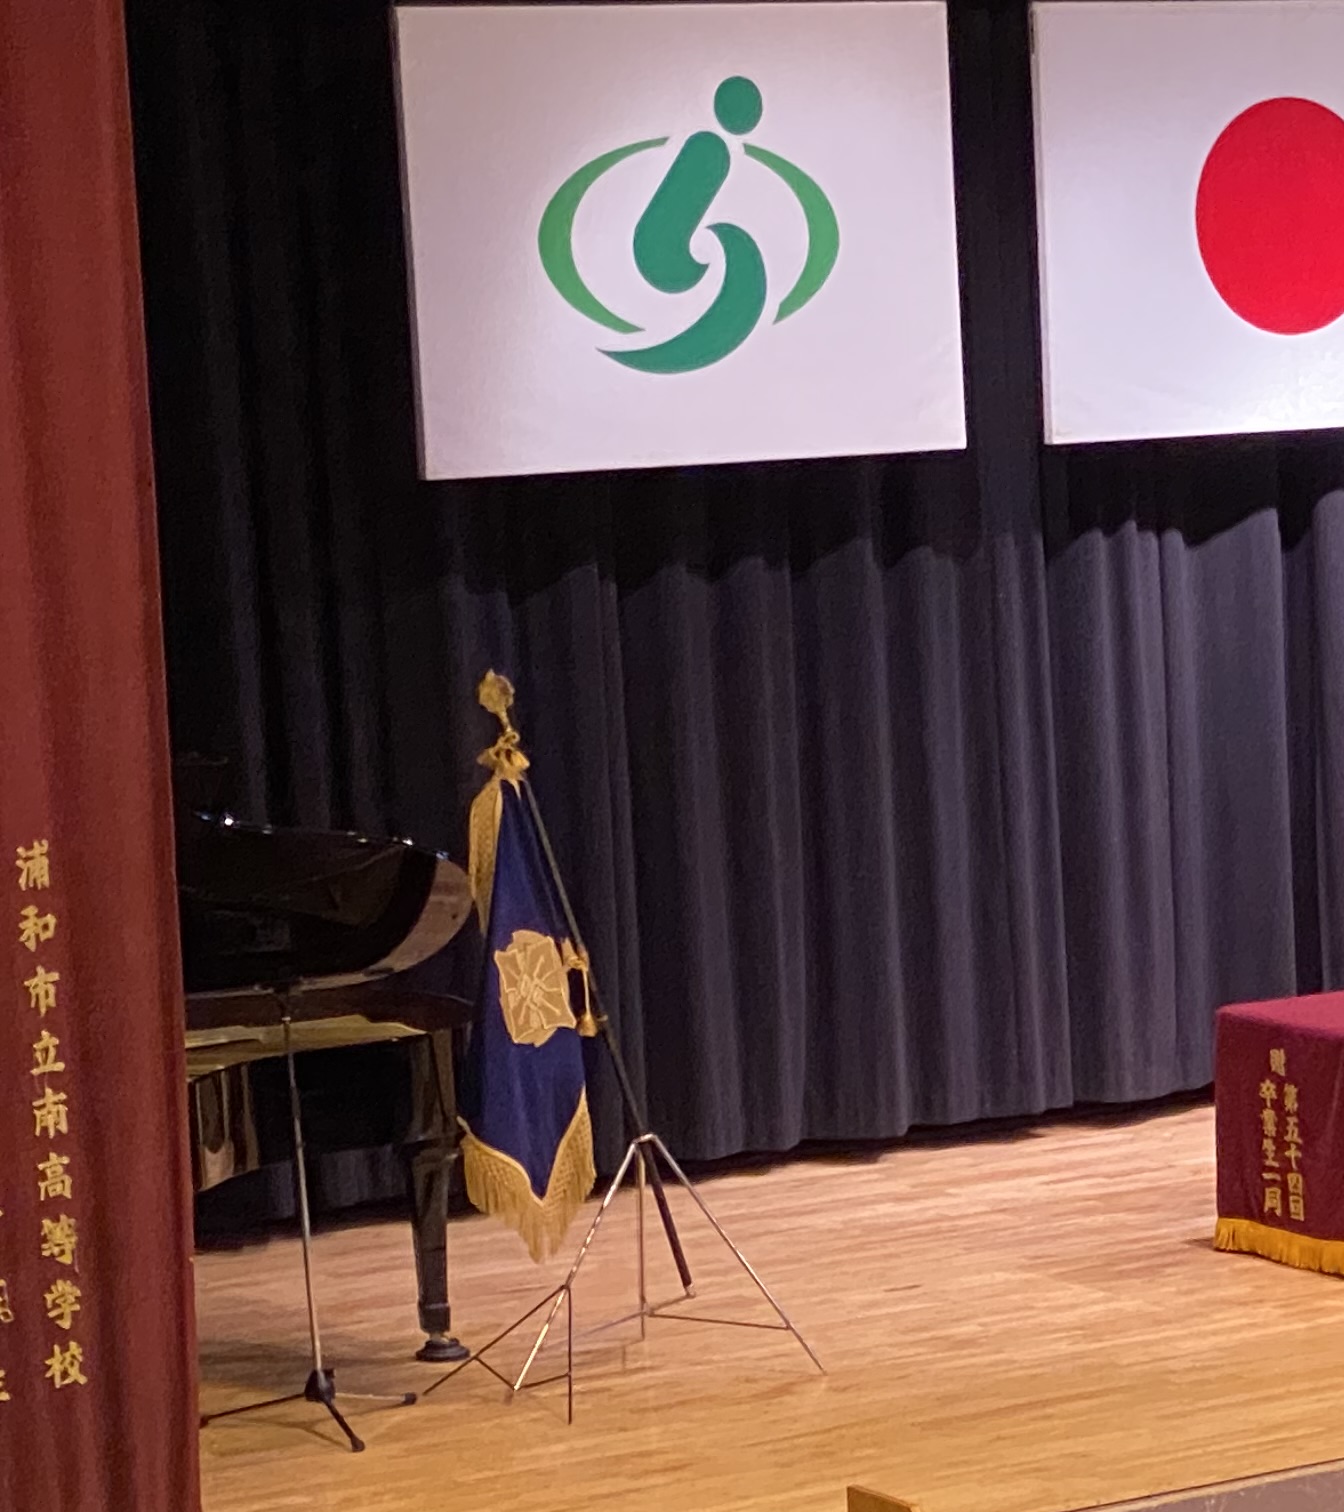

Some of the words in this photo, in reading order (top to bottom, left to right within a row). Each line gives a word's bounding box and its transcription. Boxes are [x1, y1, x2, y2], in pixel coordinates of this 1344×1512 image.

[15, 839, 88, 1389] 浦和市立南高等学校
